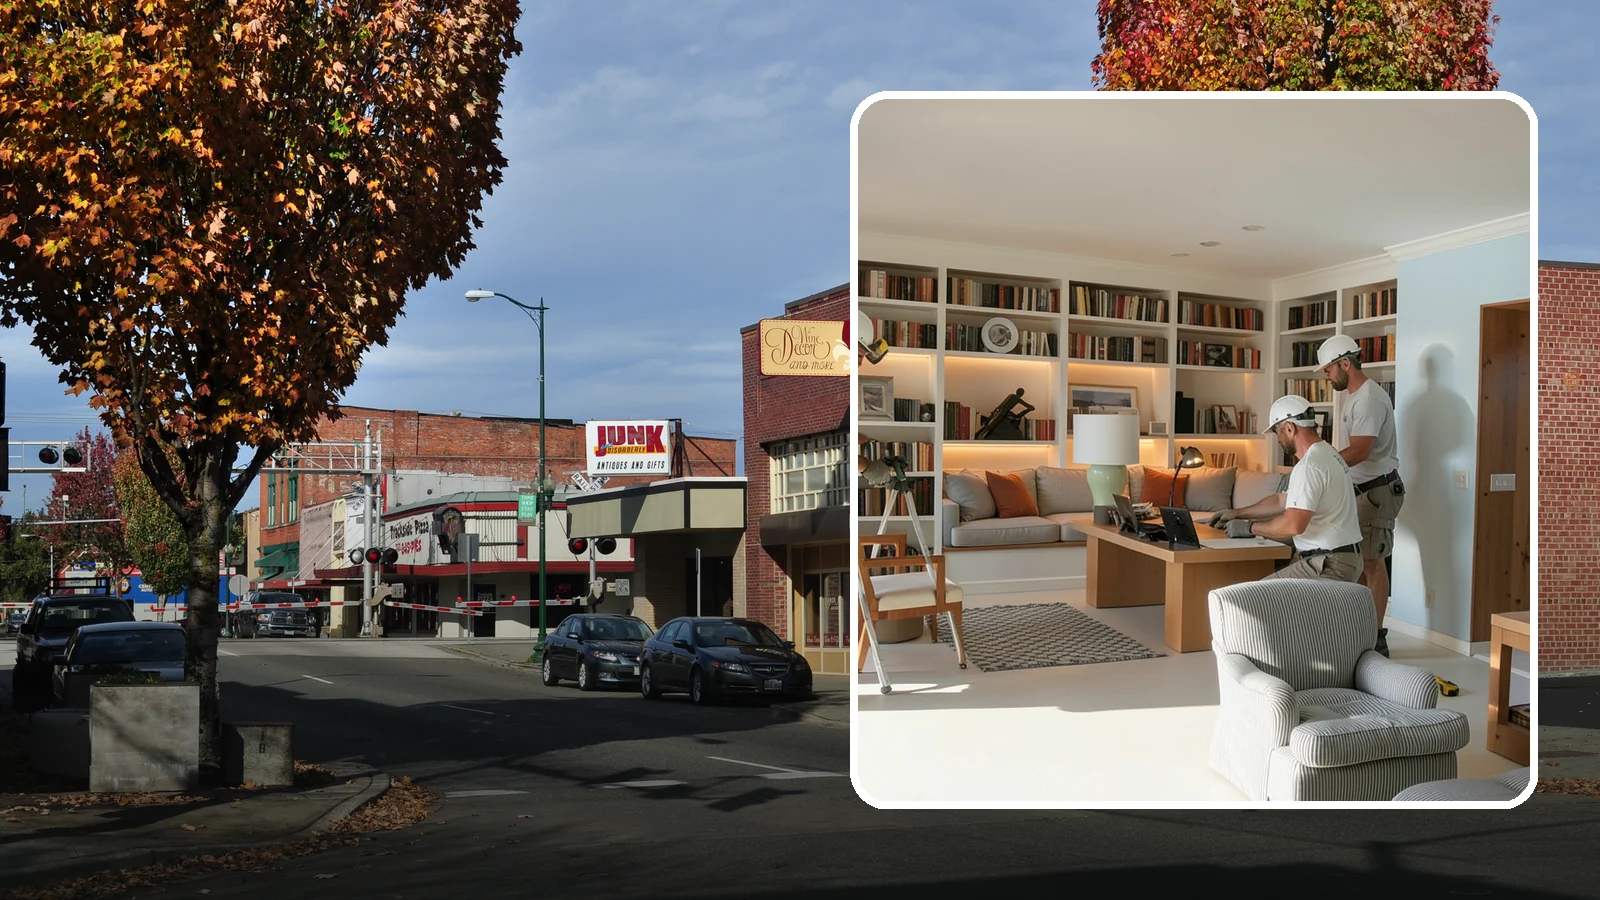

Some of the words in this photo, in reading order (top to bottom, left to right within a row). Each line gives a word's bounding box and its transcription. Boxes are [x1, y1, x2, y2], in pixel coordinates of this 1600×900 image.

[595, 425, 665, 457] JUNK
[607, 445, 646, 454] DISORDERLY
[596, 461, 628, 470] ANTIQUES
[631, 461, 644, 470] AND
[646, 460, 665, 469] GIFTS
[414, 519, 429, 535] Pizza
